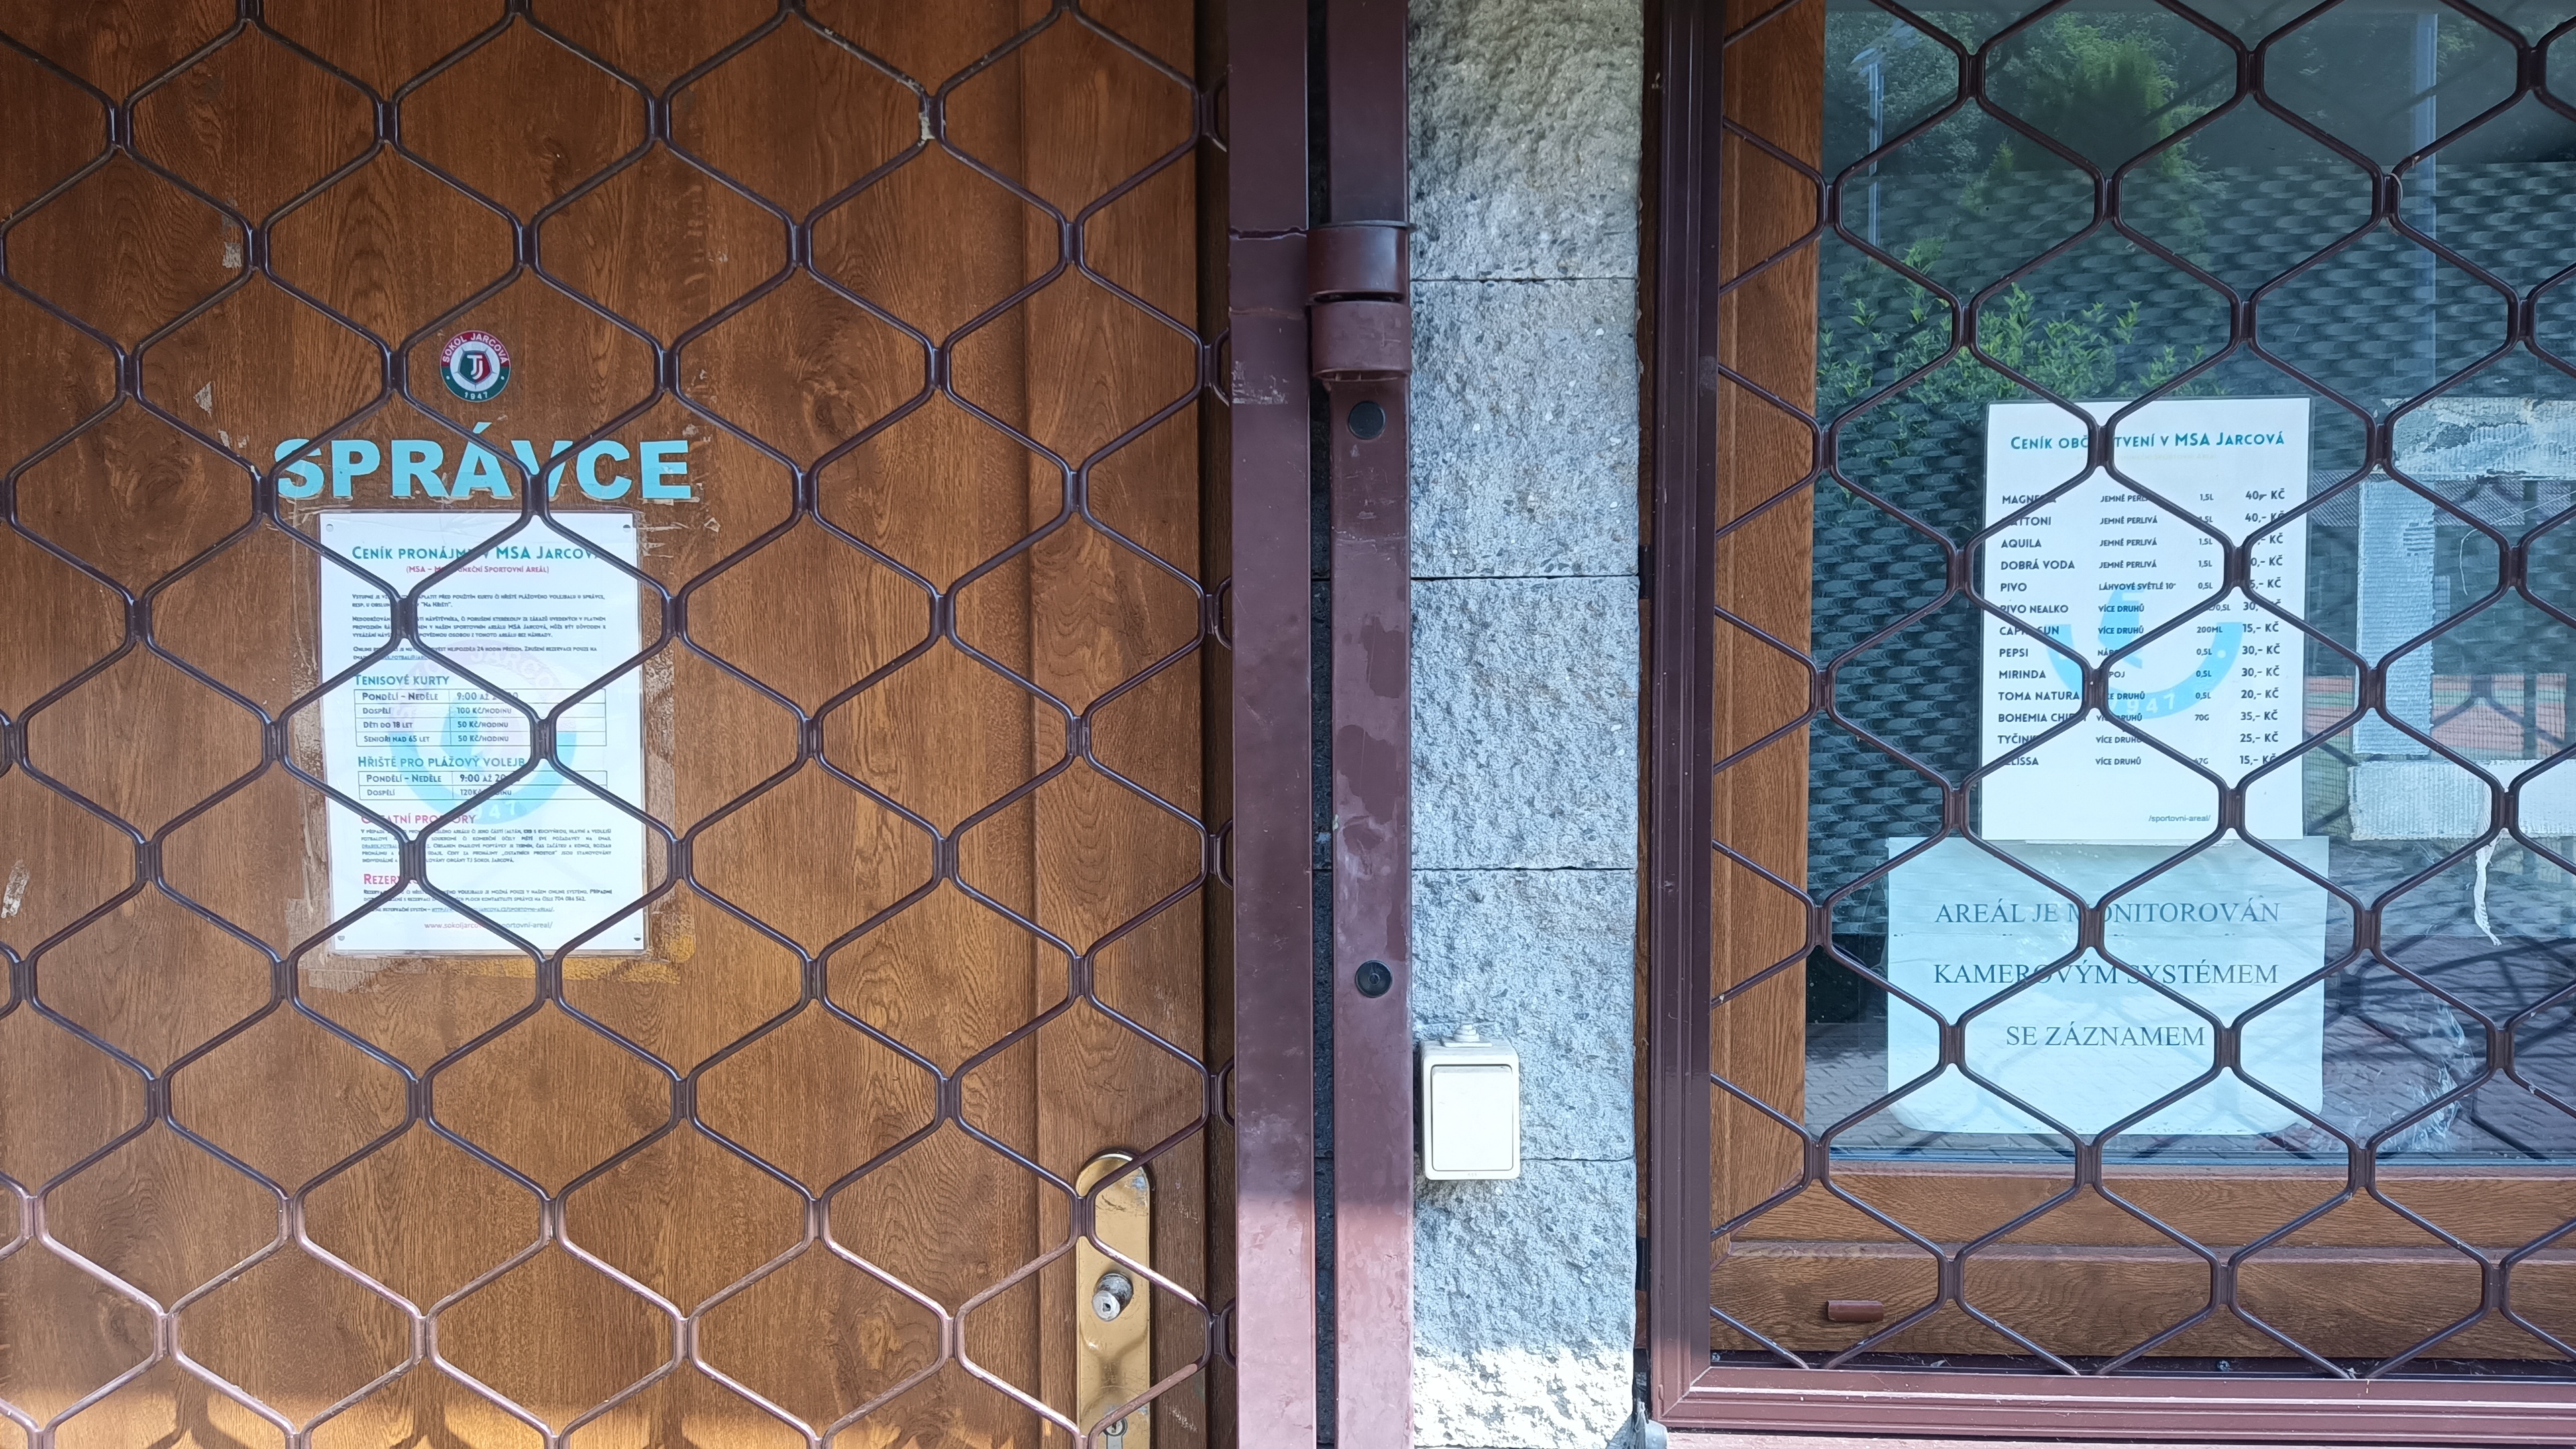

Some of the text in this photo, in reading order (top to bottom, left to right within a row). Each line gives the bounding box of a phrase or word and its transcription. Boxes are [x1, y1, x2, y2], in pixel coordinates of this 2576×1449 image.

[442, 333, 508, 364] SOKOL JARCOVÁ
[2011, 431, 2284, 449] CENÍK OBČTVENÍ V MSA JARCOVÁ
[274, 422, 692, 500] SPRÁVCE
[2245, 490, 2267, 500] 40,-
[2271, 488, 2285, 499] KČ
[2127, 516, 2157, 524] PERLIVÁ
[2245, 513, 2267, 523] 40,-
[2001, 539, 2041, 548] AQUILA
[2127, 538, 2157, 546] PERLIVÁ
[2269, 533, 2284, 543] KČ
[352, 546, 393, 559] CENÍK
[398, 546, 478, 559] PRONÁJM
[496, 546, 531, 559] MSA
[536, 546, 602, 559] JARCOV
[2001, 559, 2039, 570] DOBRÁ
[2043, 560, 2075, 569] VODA
[2126, 560, 2157, 568] PERLIVÁ
[2247, 557, 2265, 568] 0,-
[2269, 555, 2283, 566] KČ
[2000, 583, 2027, 592] PIVO
[2099, 582, 2135, 590] LÁHVOVÉ
[2247, 580, 2263, 589] 5,-
[2267, 577, 2282, 588] KČ
[2000, 604, 2026, 614] PIVO
[2030, 604, 2068, 613] NEALKO
[2098, 604, 2115, 612] VÍCE
[2117, 603, 2145, 612] DRUHŮ
[2243, 602, 2262, 611] 30,
[2117, 626, 2144, 634] DRUHŮ
[2243, 624, 2261, 633] 15,-
[2265, 621, 2279, 632] KČ
[1999, 648, 2029, 657] PEPSI
[2242, 646, 2263, 655] 30,-
[2267, 643, 2280, 654] KČ
[1999, 670, 2046, 679] MIRINDA
[2242, 667, 2262, 678] 30,-
[2266, 665, 2279, 676] KČ
[355, 674, 449, 686] TENISOVÉ KURTY
[362, 692, 398, 700] PONDĚLÍ
[408, 692, 438, 700] NEDĚLE
[457, 692, 477, 700] 9:00
[1998, 692, 2031, 701] TOMA
[2035, 692, 2080, 700] NATURA
[2117, 691, 2145, 700] DRUHŮ
[2241, 690, 2261, 700] 20,-
[2265, 688, 2279, 698] KČ
[1998, 714, 2047, 722] BOHEMIA
[2241, 712, 2261, 721] 35,-
[2264, 710, 2278, 720] KČ
[2240, 733, 2261, 743] 25,-
[2265, 731, 2278, 742] KČ
[358, 756, 529, 767] HŘIŠTĚ PRO PLÁŽOVÝ VOLEJB
[2002, 757, 2039, 765] LISSA
[2114, 757, 2141, 765] DRUHŮ
[2240, 755, 2258, 765] 15,-
[366, 774, 402, 782] PONDĚLÍ
[412, 774, 441, 782] NEDĚLE
[460, 774, 480, 782] 9:00
[2149, 815, 2211, 823] /sportovni-areal/
[1935, 898, 2025, 923] AREÁL
[2032, 902, 2057, 923] JE
[1934, 959, 2278, 984] KAMEROVÝM SYSTÉMEM
[2006, 1021, 2205, 1046] SE ZÁZNAMEM
